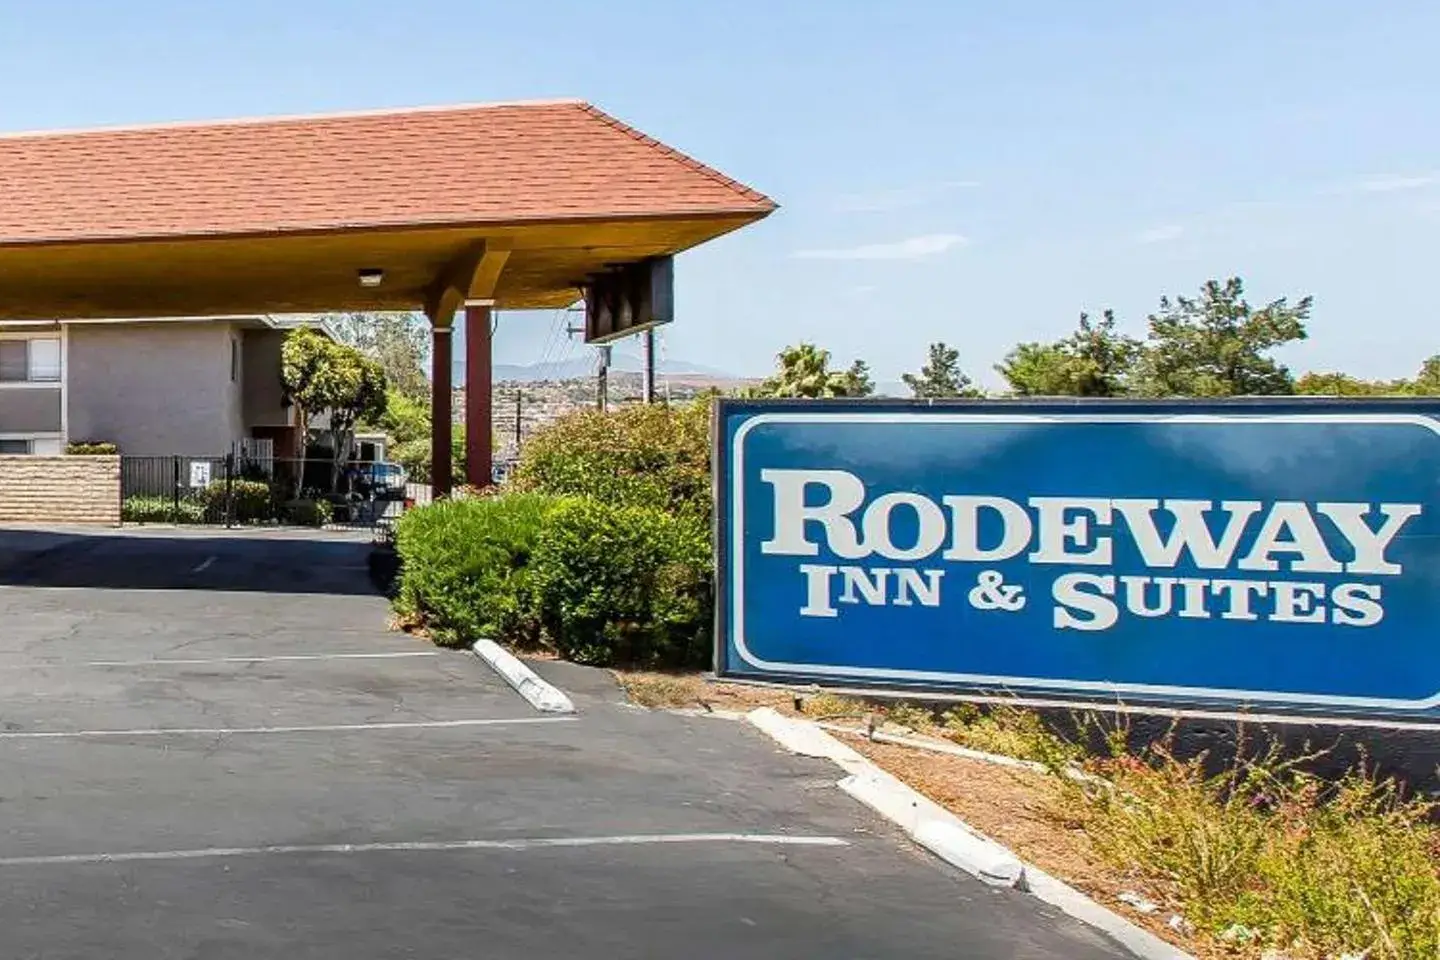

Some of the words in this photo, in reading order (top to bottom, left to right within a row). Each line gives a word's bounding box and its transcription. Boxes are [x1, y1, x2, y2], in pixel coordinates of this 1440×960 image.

[760, 467, 1423, 576] RODEWAY
[799, 563, 946, 618] INN
[967, 569, 1027, 612] &
[1051, 571, 1385, 632] SUITES
